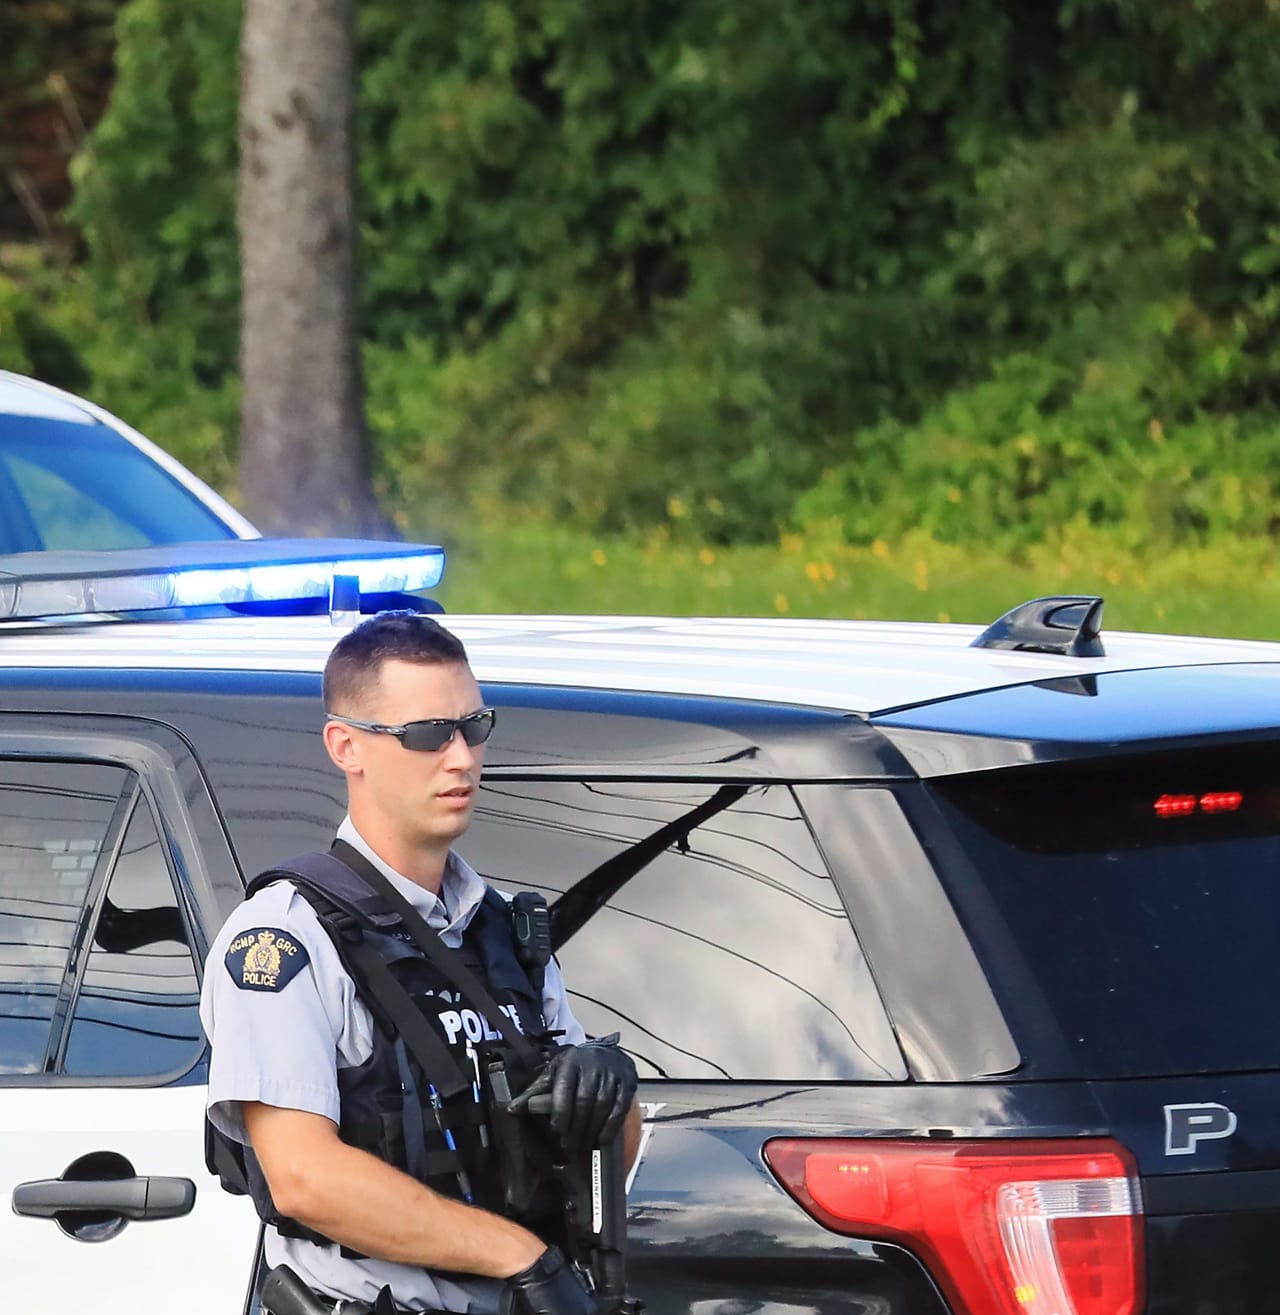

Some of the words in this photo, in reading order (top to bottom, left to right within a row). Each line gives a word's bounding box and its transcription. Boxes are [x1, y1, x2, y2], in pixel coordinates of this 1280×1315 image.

[229, 934, 256, 955] RCMP
[275, 937, 298, 956] GRC
[242, 972, 277, 988] POLICE
[438, 1004, 525, 1045] POLE
